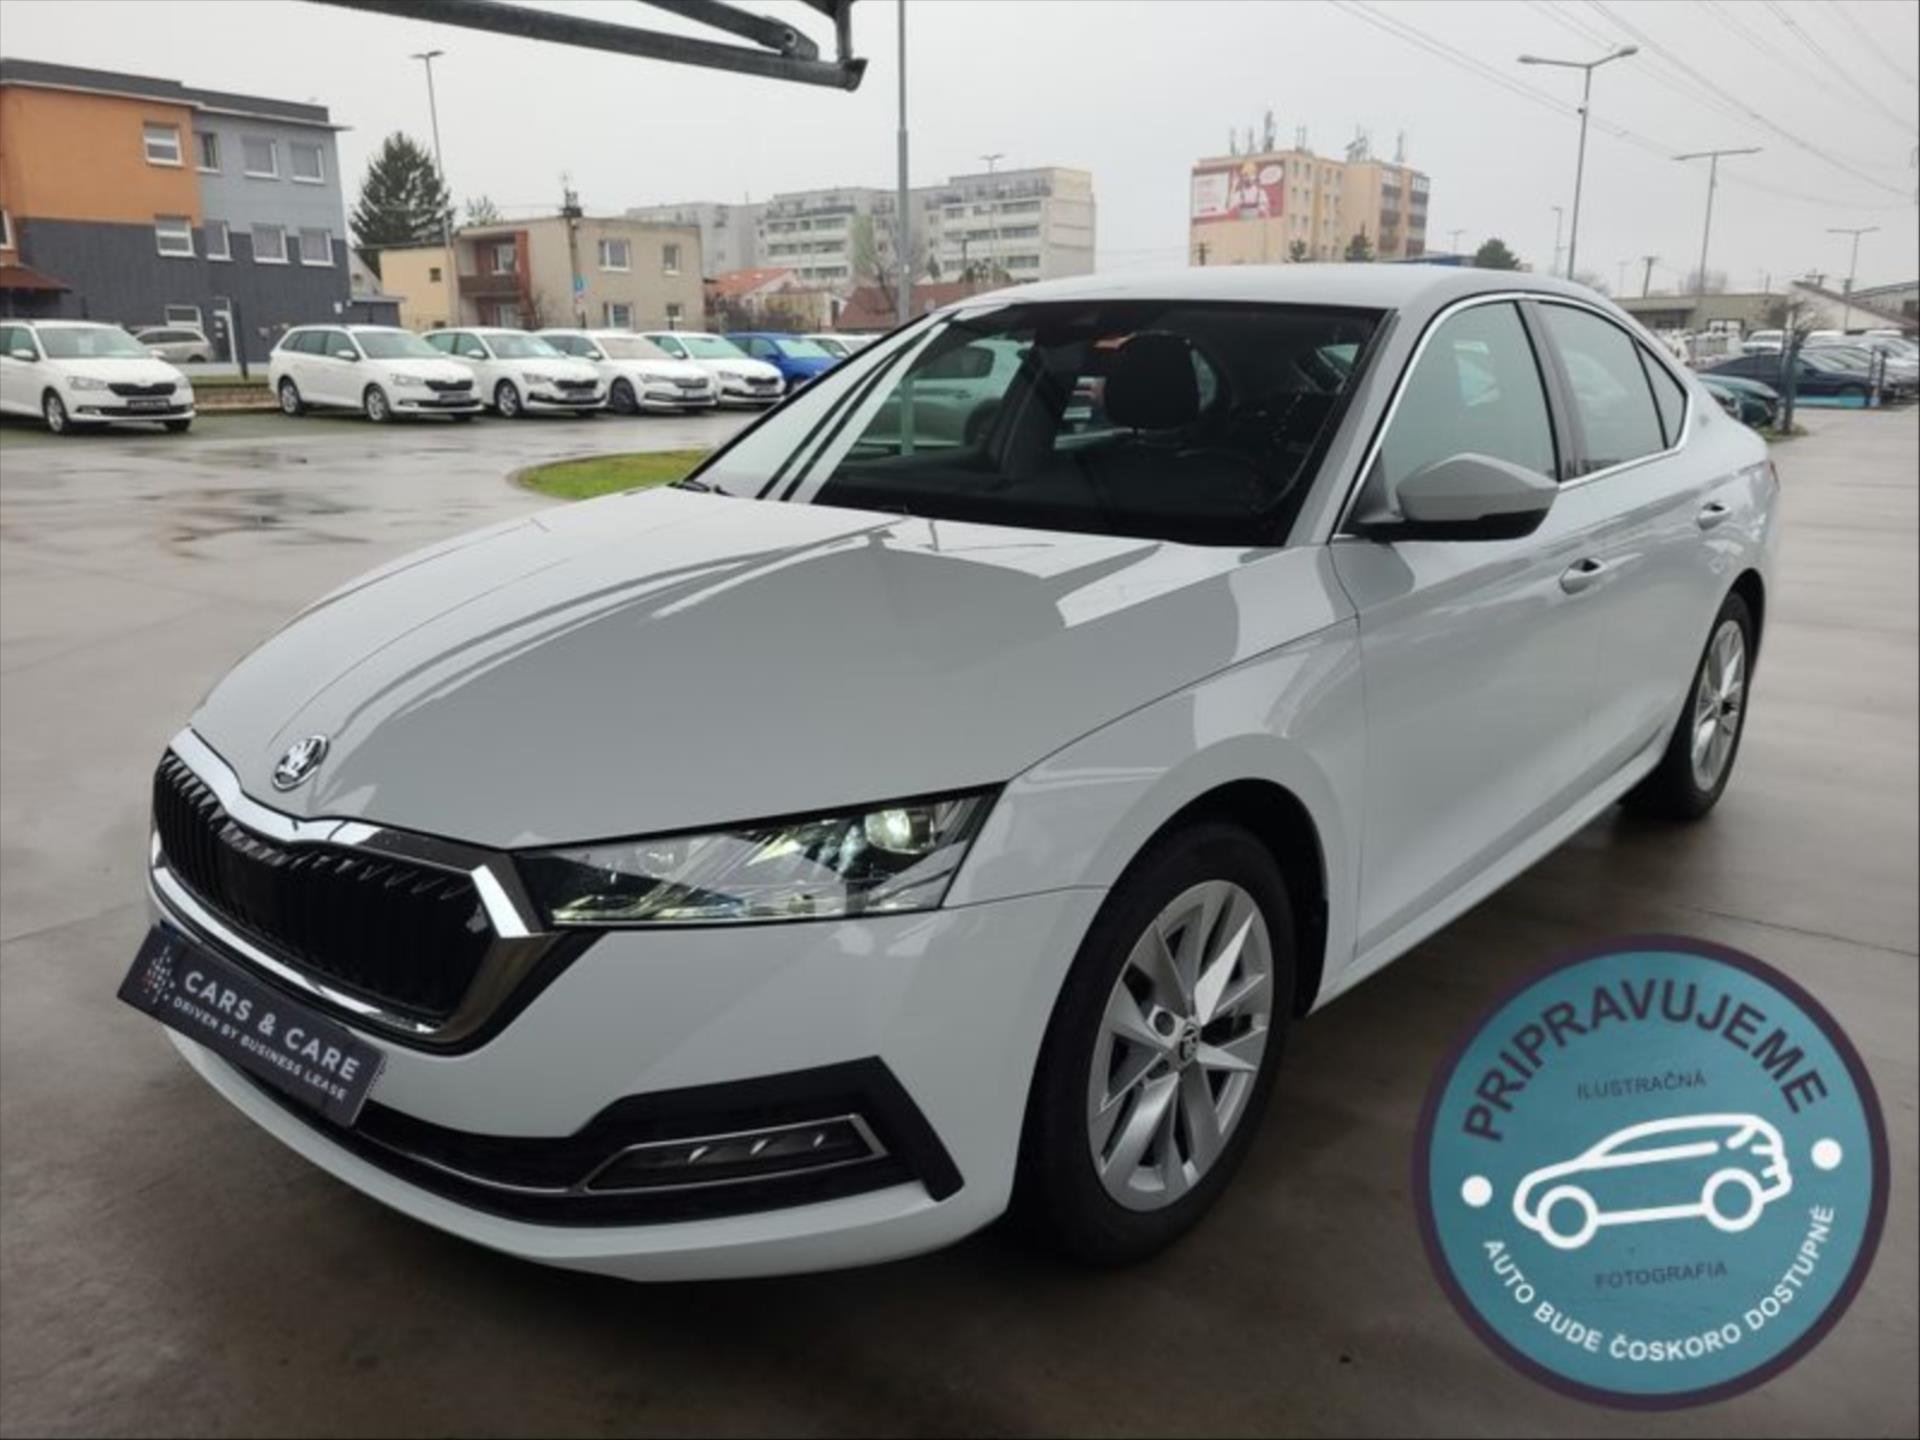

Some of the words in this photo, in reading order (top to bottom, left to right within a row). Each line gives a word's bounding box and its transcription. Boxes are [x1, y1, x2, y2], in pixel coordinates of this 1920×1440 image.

[174, 997, 218, 1028] DRIVEN
[221, 1020, 238, 1038] BY
[240, 1036, 302, 1075] BUSINESS
[304, 1070, 348, 1100] LEASE
[184, 971, 253, 1021] CARS
[257, 1013, 277, 1037] &
[284, 1028, 360, 1081] CARE
